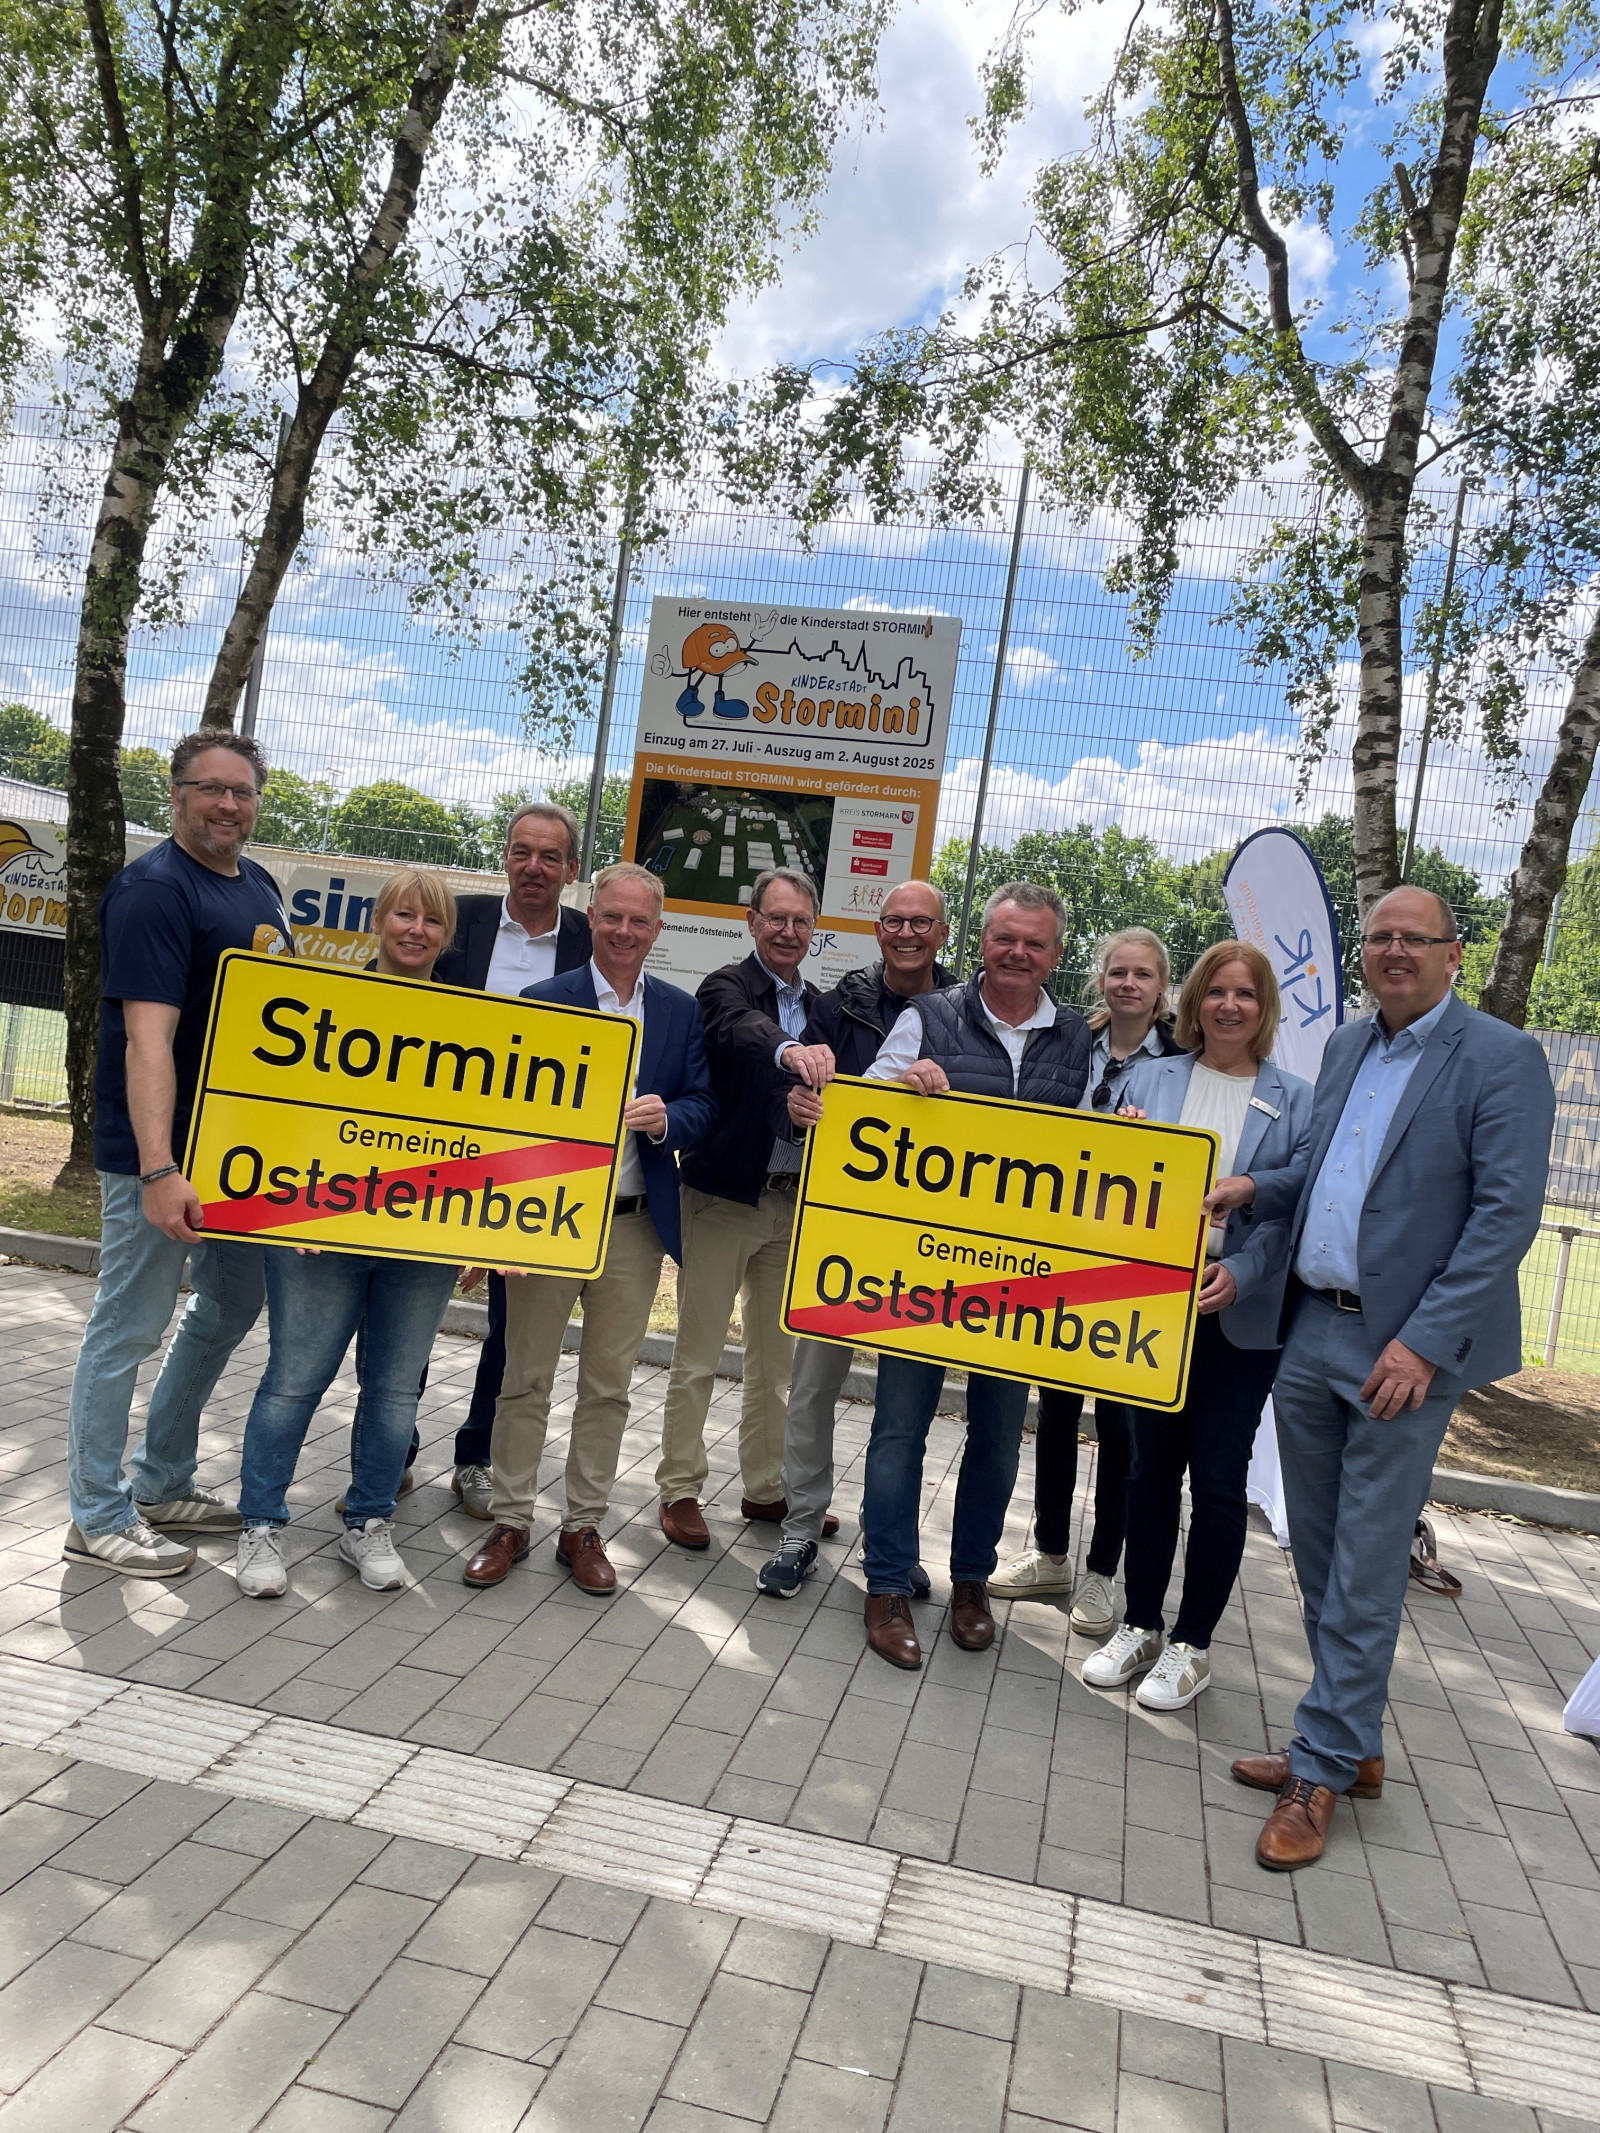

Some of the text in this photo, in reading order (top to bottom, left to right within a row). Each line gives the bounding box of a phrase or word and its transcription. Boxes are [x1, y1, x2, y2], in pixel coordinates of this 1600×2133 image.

[678, 606, 933, 635] Hier entsteht die Kinderstadt STORMINI
[791, 674, 868, 693] KINDERSTADT
[753, 681, 921, 735] Stormini
[644, 732, 686, 749] Einzug
[689, 739, 708, 749] am
[711, 739, 728, 751] 27.
[732, 741, 753, 753] Juli
[764, 744, 811, 761] Auszug
[815, 750, 834, 761] am
[838, 751, 849, 762] 2.
[852, 752, 899, 767] August
[903, 757, 935, 770] 2025
[645, 762, 921, 798] Die Kinderstadt STORMINI wird gefördert durch:
[839, 808, 899, 820] KREIS STORMARN
[662, 922, 743, 939] Gemeinde Oststeinbek
[251, 996, 592, 1110] Stormini
[338, 1119, 481, 1161] Gemeinde
[218, 1145, 586, 1240] Oststeinbek
[841, 1116, 1166, 1230] Stormini
[917, 1233, 1052, 1279] Gemeinde
[816, 1254, 1164, 1370] Oststeinbek
